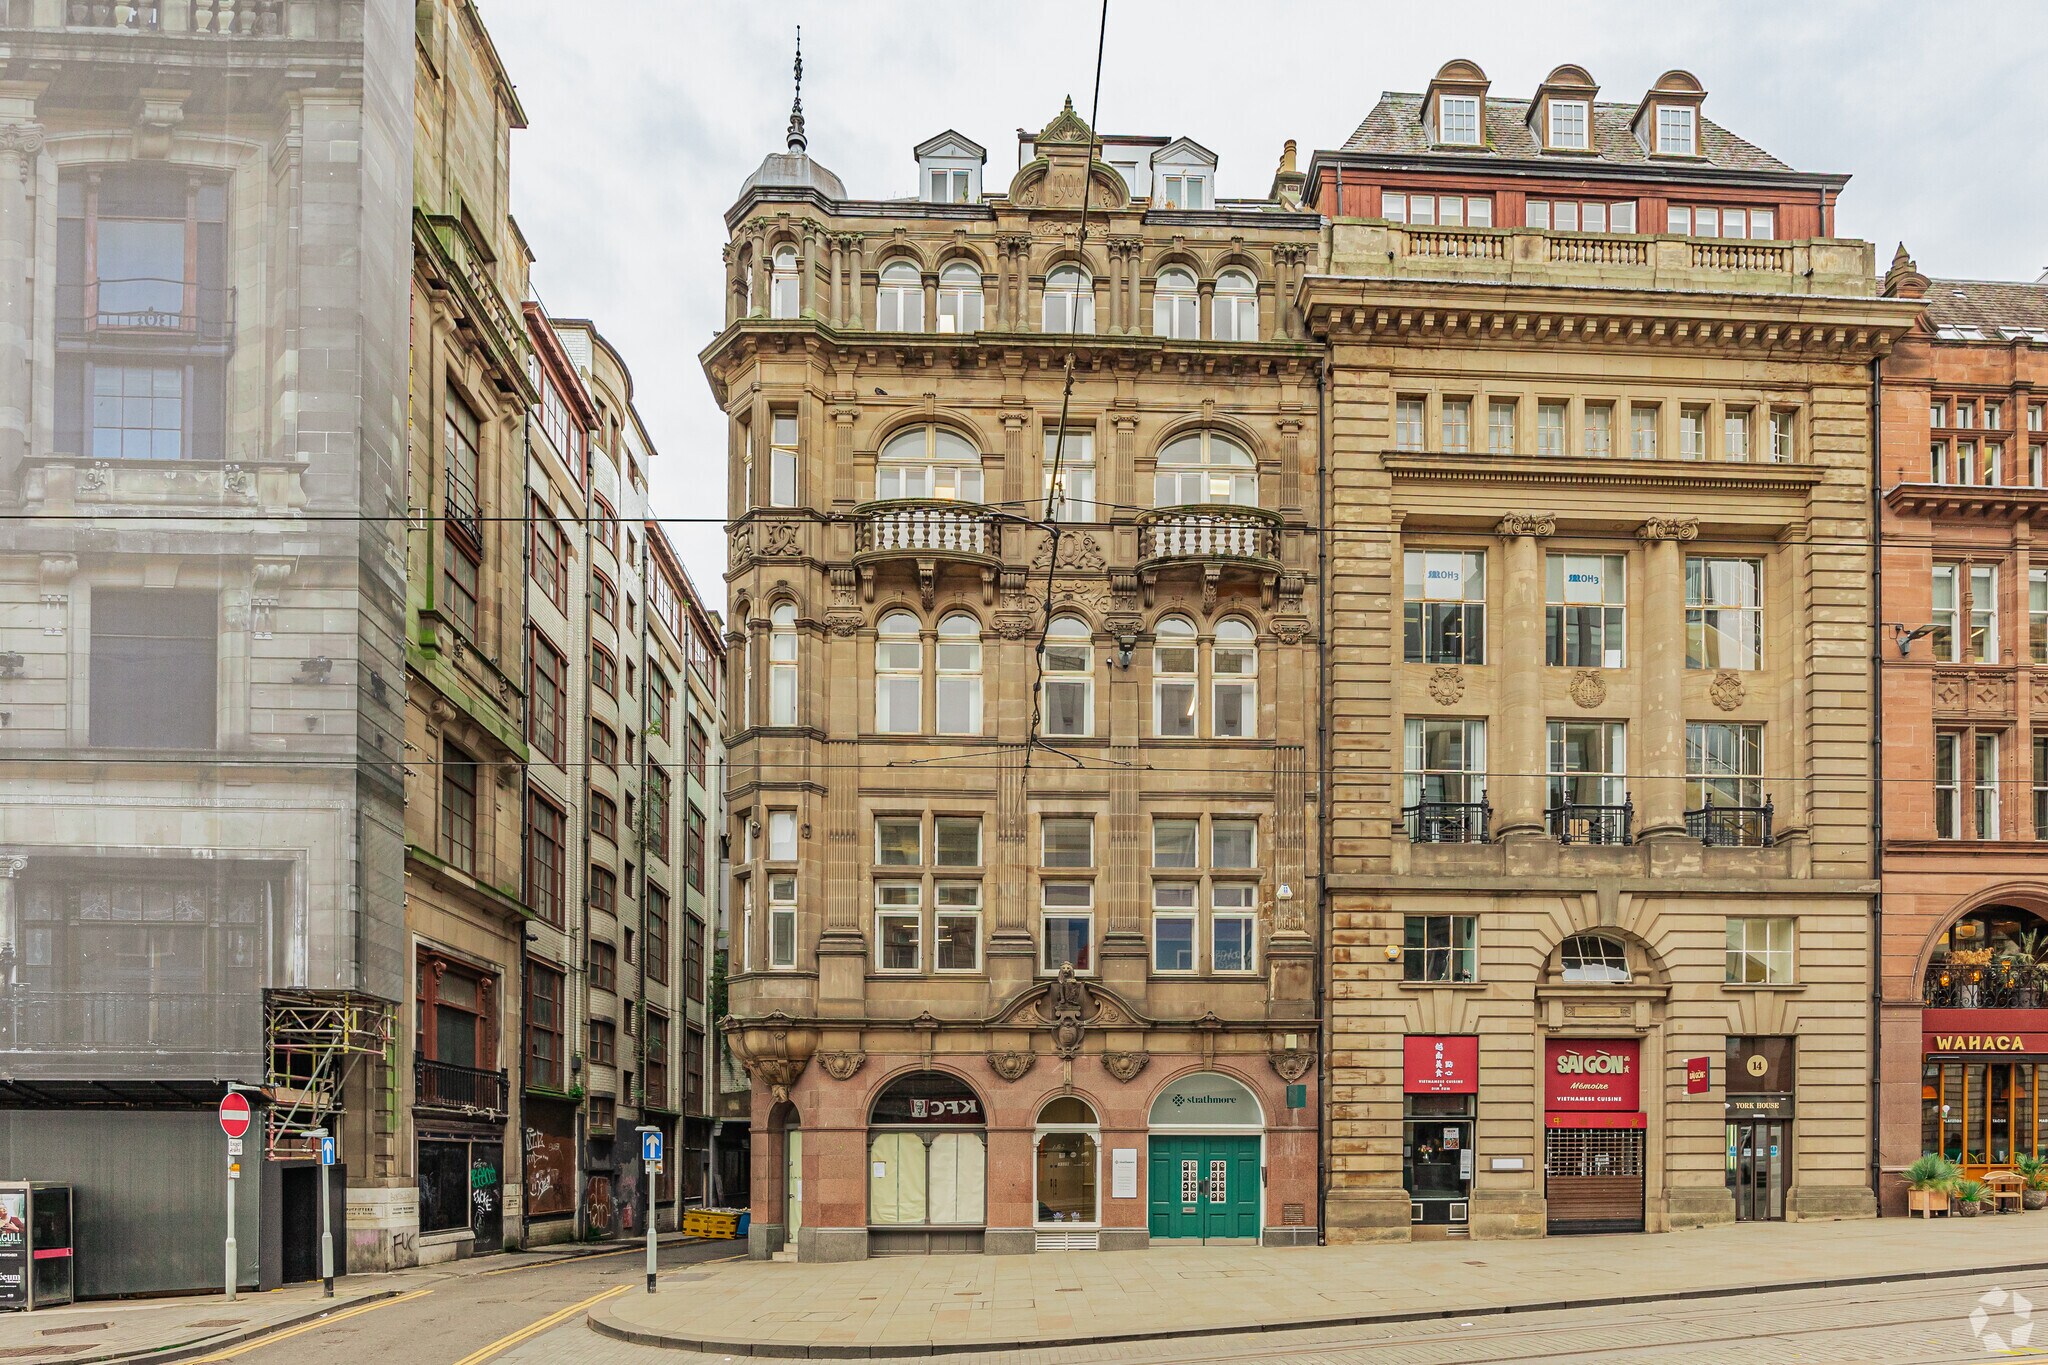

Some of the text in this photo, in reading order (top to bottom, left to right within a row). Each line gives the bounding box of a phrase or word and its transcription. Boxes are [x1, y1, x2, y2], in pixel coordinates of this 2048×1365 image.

[1936, 1035, 2025, 1051] WAHACA
[1752, 1061, 1763, 1071] 14
[1186, 1094, 1237, 1104] strathmore
